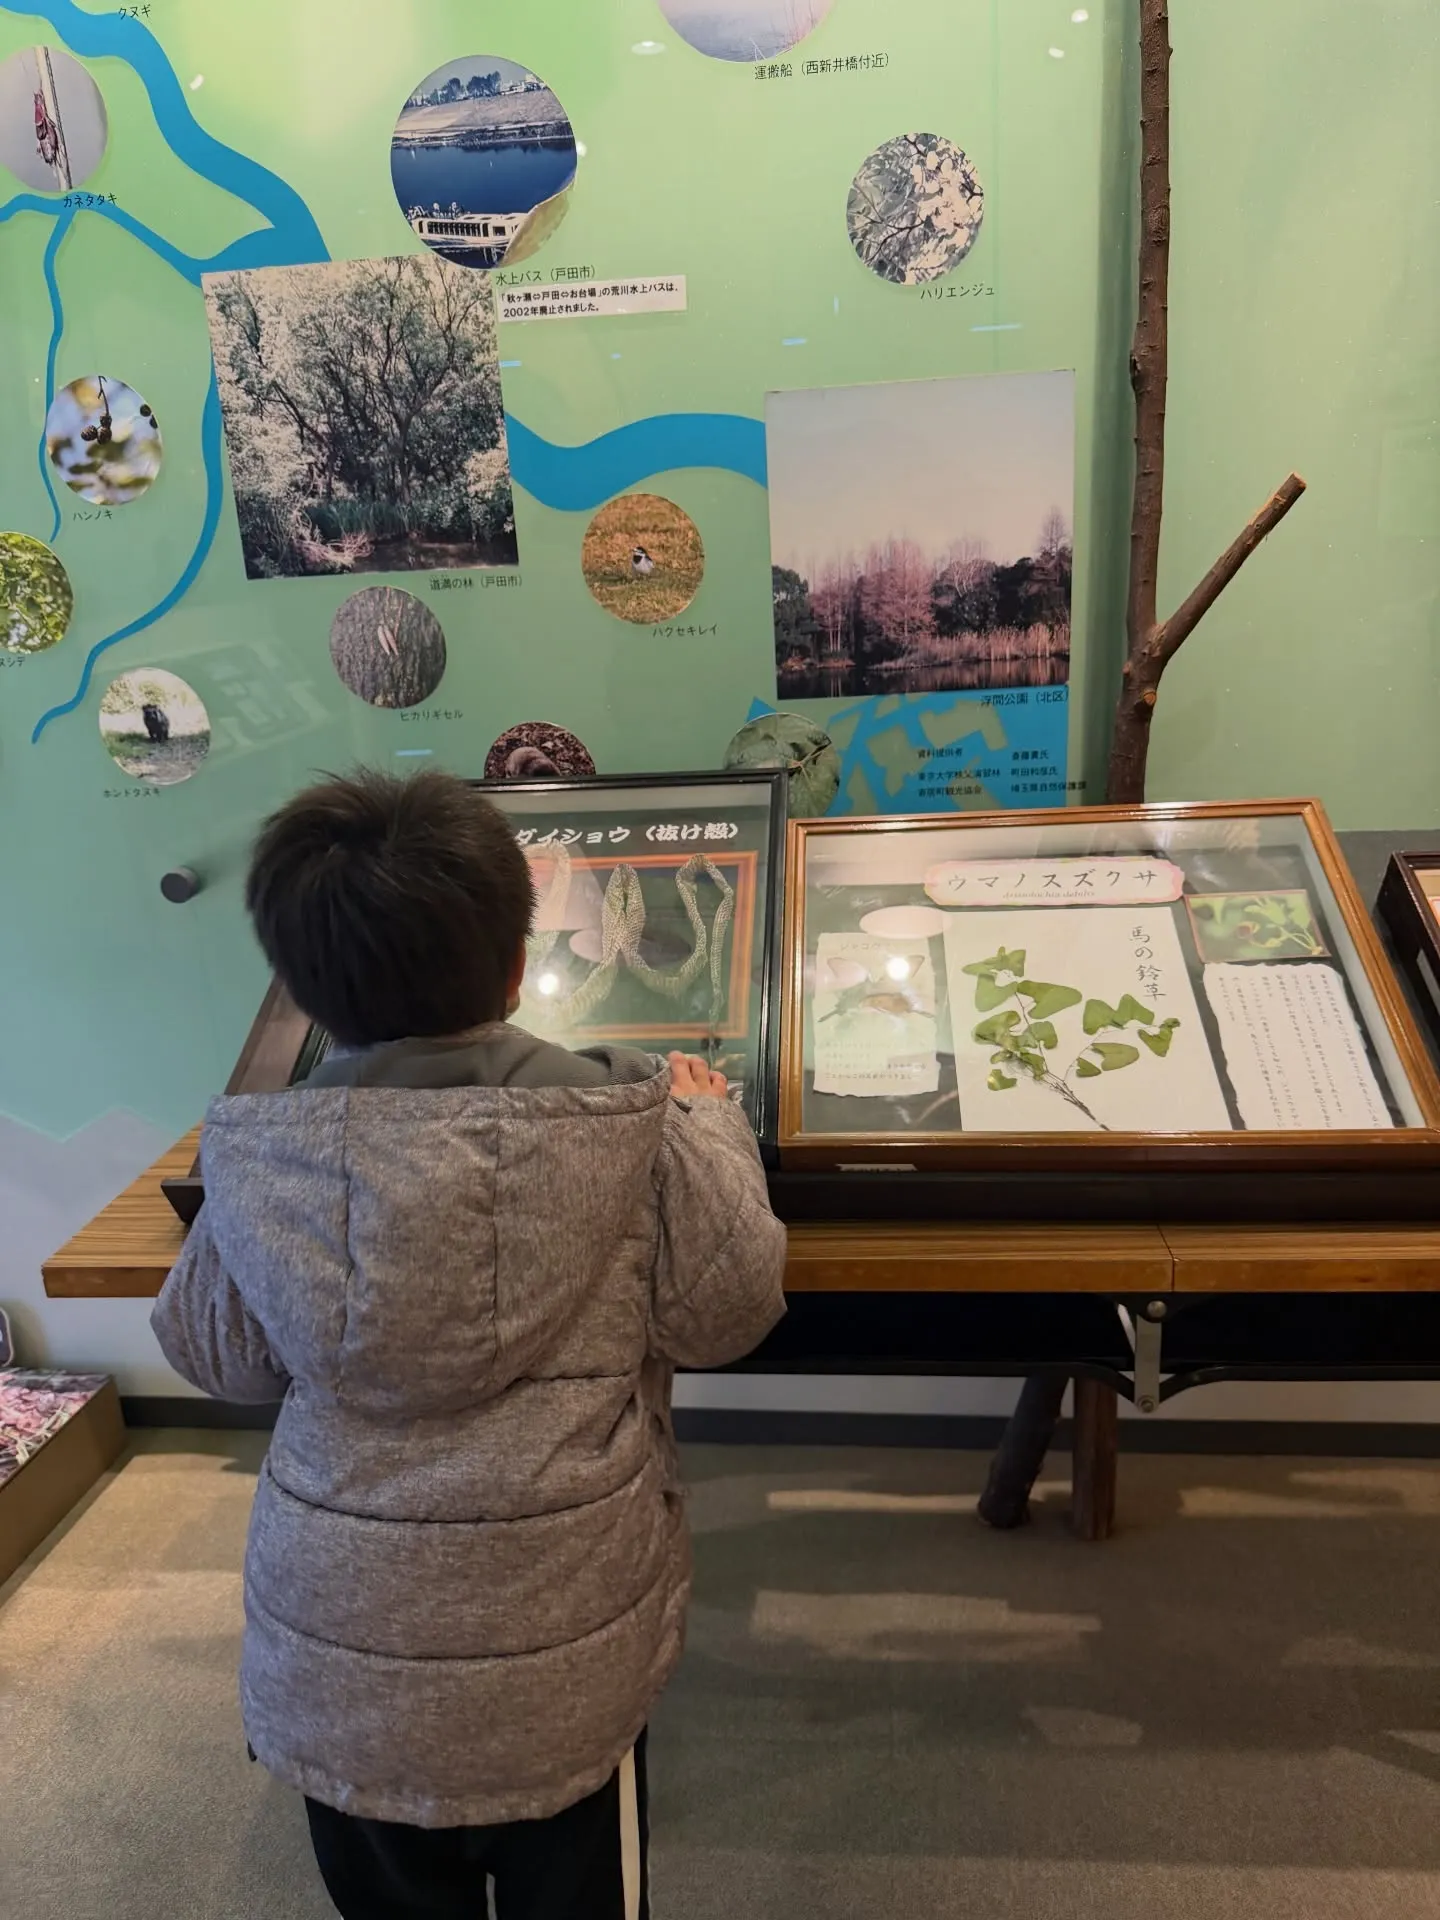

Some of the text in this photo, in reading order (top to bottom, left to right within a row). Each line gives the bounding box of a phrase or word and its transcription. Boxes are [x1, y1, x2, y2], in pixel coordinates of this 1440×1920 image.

[118, 4, 151, 20] クヌギ
[63, 193, 118, 208] カネタタキ
[920, 283, 995, 300] ハリエンジュ
[73, 509, 113, 521] ハンノキ
[653, 622, 719, 638] ハクセキレイ
[400, 709, 463, 722] ヒカリギセル
[103, 787, 161, 799] ホンドタヌキ
[948, 868, 1158, 892] ウマノスズクサ
[1128, 925, 1167, 1002] 馬の鈴草
